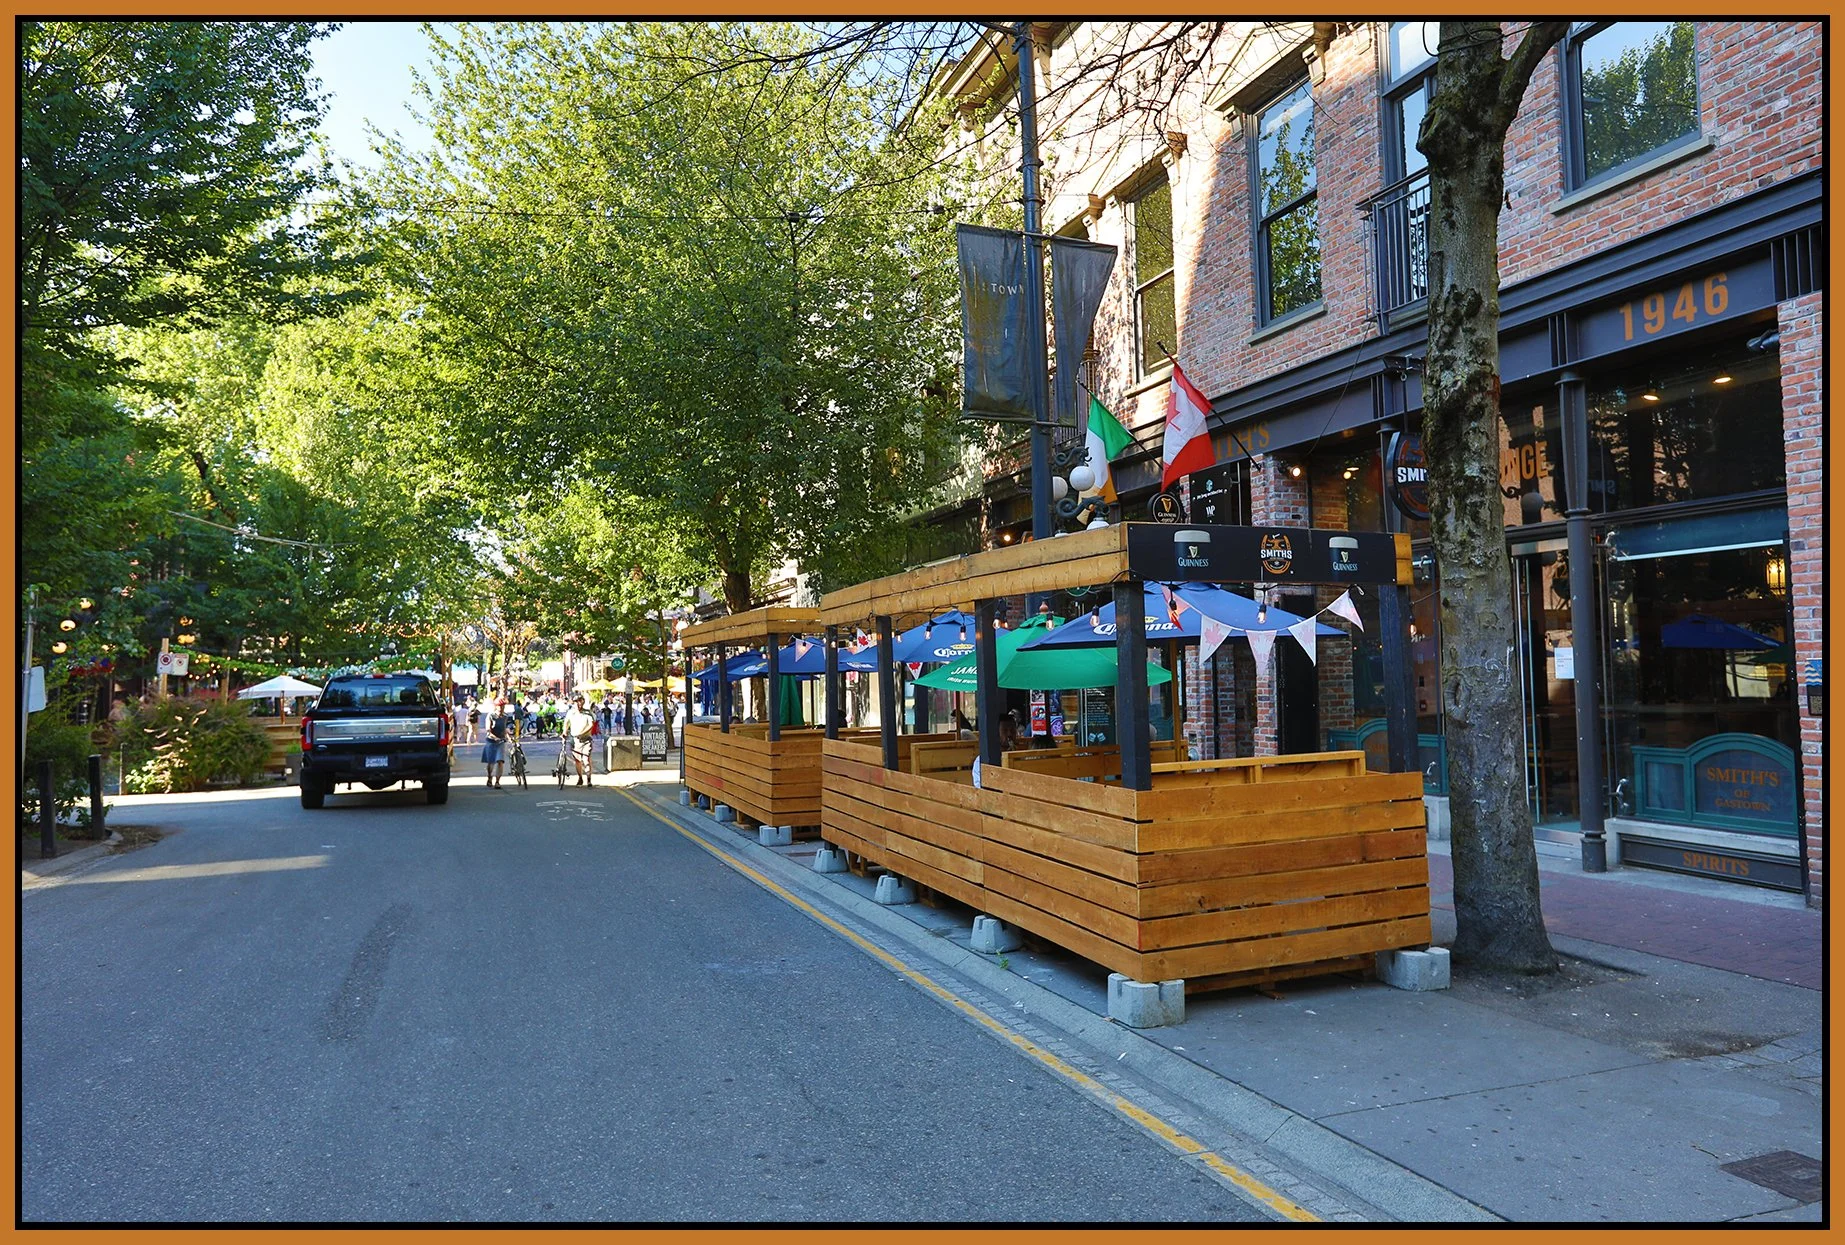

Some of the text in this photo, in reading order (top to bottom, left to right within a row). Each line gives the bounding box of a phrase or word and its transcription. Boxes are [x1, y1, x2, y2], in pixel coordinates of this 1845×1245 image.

[1619, 272, 1729, 341] 1946
[1397, 466, 1428, 483] SMI
[1260, 549, 1293, 560] SMITHS
[1178, 556, 1209, 568] GUINNESS
[1332, 561, 1358, 572] GUINNESS
[1707, 767, 1779, 787] SMITH'S
[1734, 788, 1751, 799] OF
[1715, 798, 1771, 811] GASTOWN
[1682, 852, 1750, 876] SPIRITS
